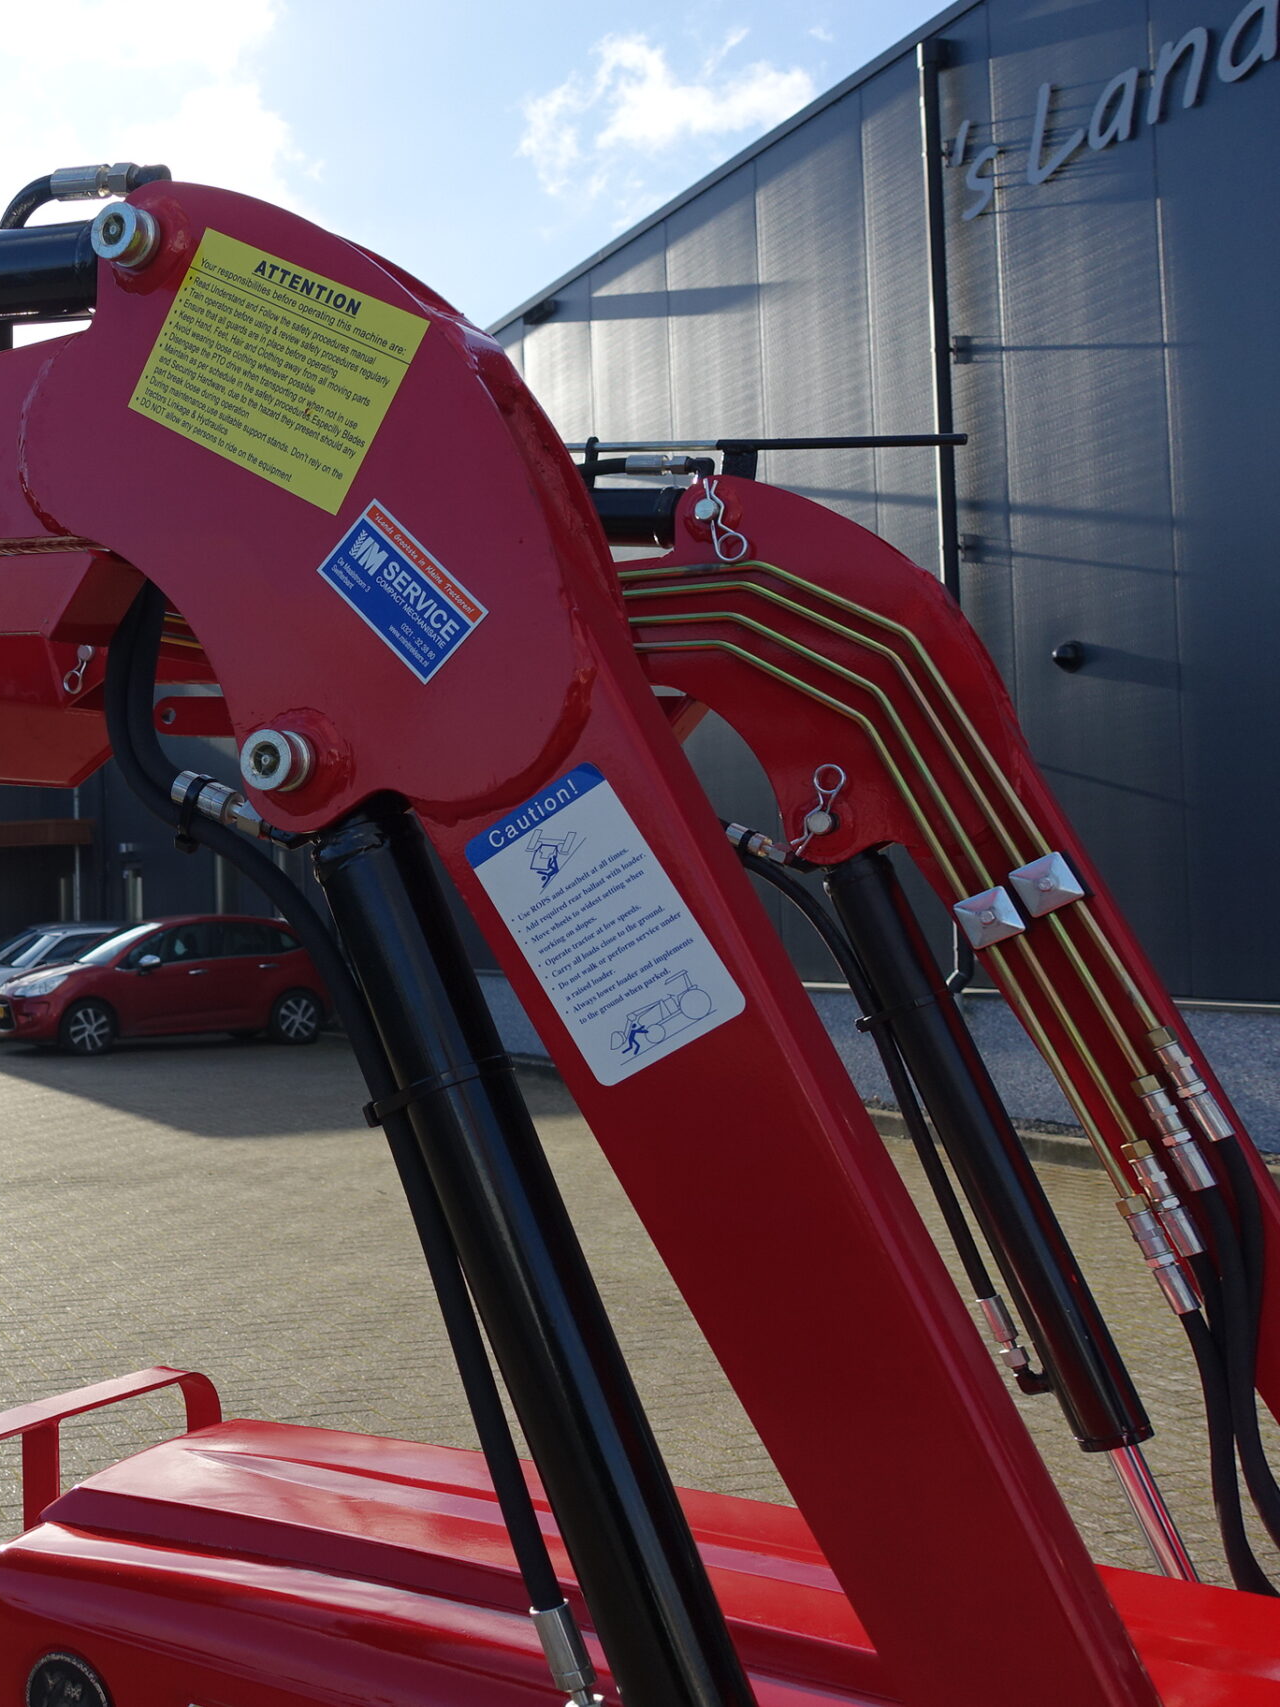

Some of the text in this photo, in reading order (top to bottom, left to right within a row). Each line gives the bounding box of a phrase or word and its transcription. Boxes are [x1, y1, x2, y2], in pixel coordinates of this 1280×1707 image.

[200, 256, 406, 356] Your responsibilities before operating this machine are:
[253, 259, 362, 316] ATTENTION
[172, 320, 316, 396] Avoid wearing loose clothing whenever possible
[177, 309, 195, 326] Keep
[229, 333, 245, 347] Hair
[243, 341, 259, 354] and
[256, 346, 284, 368] Clothing
[282, 360, 302, 376] away
[301, 367, 318, 382] from
[317, 375, 328, 387] all
[326, 380, 353, 400] moving
[350, 392, 371, 407] parts
[182, 298, 339, 379] Ensure that all guards are in place before operating
[188, 287, 391, 388] Train operators before using & review safety procedures regularly
[244, 300, 259, 313] and
[257, 305, 281, 322] Follow
[279, 315, 292, 328] the
[290, 321, 313, 338] safety
[310, 331, 350, 354] procedures
[349, 347, 377, 366] manual
[167, 331, 358, 430] Disengage the PTO drive when transporting or when not in use
[138, 396, 292, 483] DO NOT allow any persons to ride on the equipment
[382, 560, 460, 642] SERVICE
[417, 557, 426, 566] in
[424, 564, 443, 584] Kleine
[375, 575, 446, 649] COMPACT MECHANISATIE
[487, 779, 578, 848] Caution!
[517, 910, 531, 921] Use
[529, 895, 551, 913] ROPS
[550, 886, 565, 900] and
[564, 871, 591, 892] seatbelt
[589, 865, 598, 874] at
[597, 858, 608, 870] all
[524, 919, 540, 933] Add
[538, 900, 568, 924] required
[567, 892, 582, 905] rear
[581, 877, 606, 895] ballast
[605, 867, 622, 880] with
[530, 869, 645, 944] Move wheels to widest setting when
[537, 934, 567, 955] working
[565, 929, 575, 938] on
[544, 946, 572, 967] Operate
[571, 931, 596, 950] tractor
[595, 926, 604, 935] at
[602, 918, 616, 930] low
[551, 962, 573, 978] Carry
[571, 954, 582, 965] all
[580, 944, 600, 960] loads
[599, 934, 617, 948] close
[616, 929, 625, 938] to
[624, 921, 637, 933] the
[557, 910, 681, 990] Do not walk or perform service under
[572, 936, 694, 1013] Always lower loader and implements
[570, 980, 592, 998] raised
[578, 1016, 588, 1025] to
[586, 1009, 599, 1020] the
[598, 993, 625, 1015] ground
[623, 983, 644, 998] when
